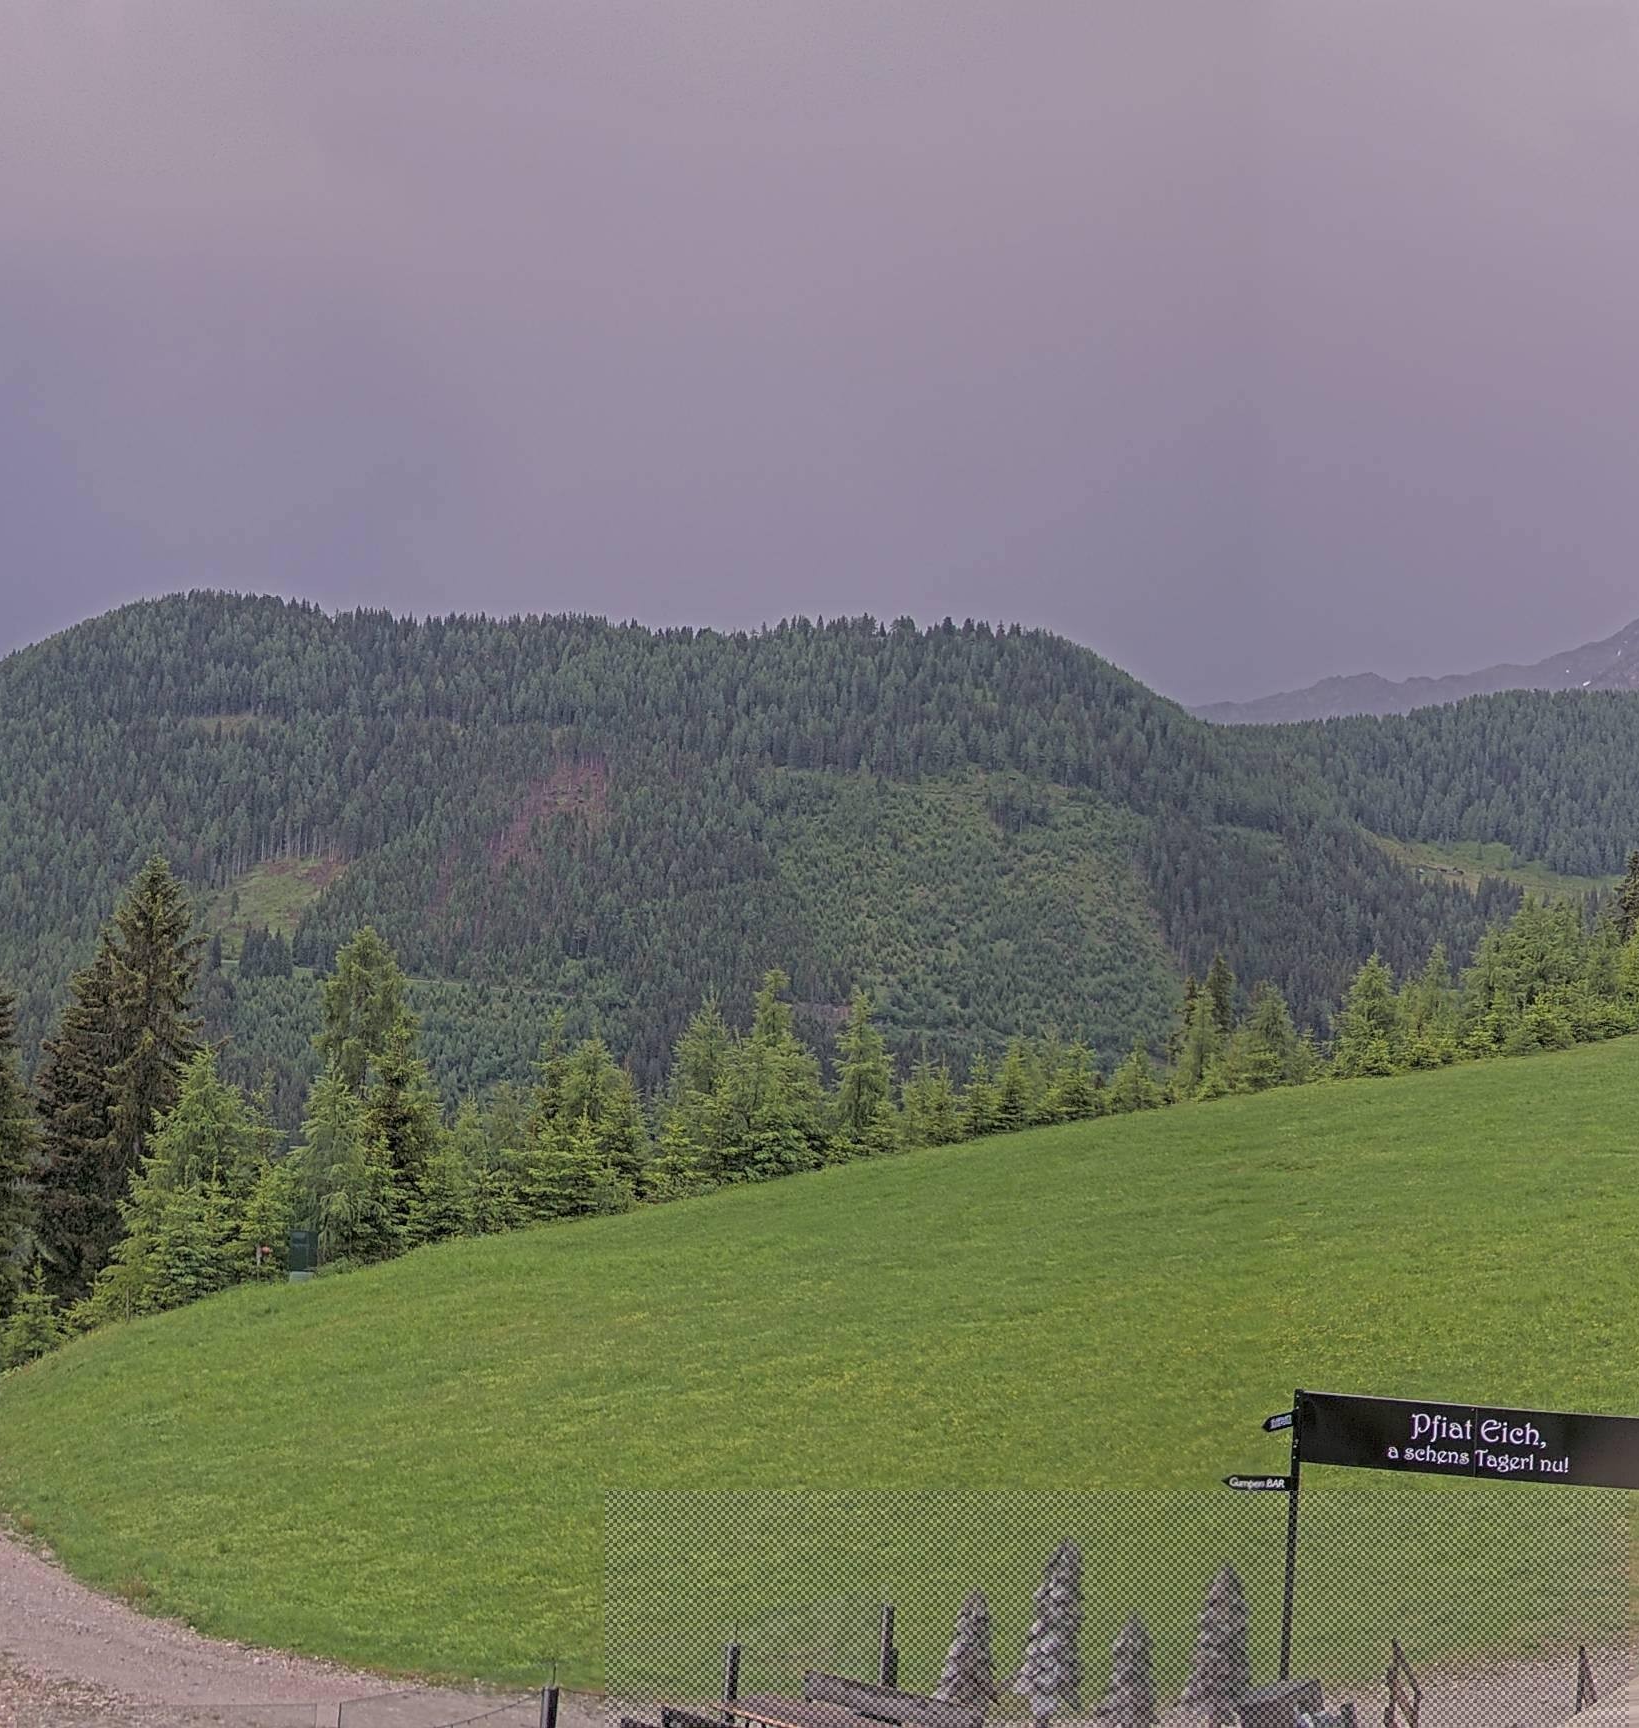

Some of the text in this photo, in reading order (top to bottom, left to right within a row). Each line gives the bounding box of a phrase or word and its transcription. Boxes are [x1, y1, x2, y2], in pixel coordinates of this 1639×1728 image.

[1410, 1413, 1547, 1449] Pfiat Eich,
[1387, 1445, 1570, 1473] a schens Tagerl nu!
[1266, 1477, 1285, 1488] BAR
